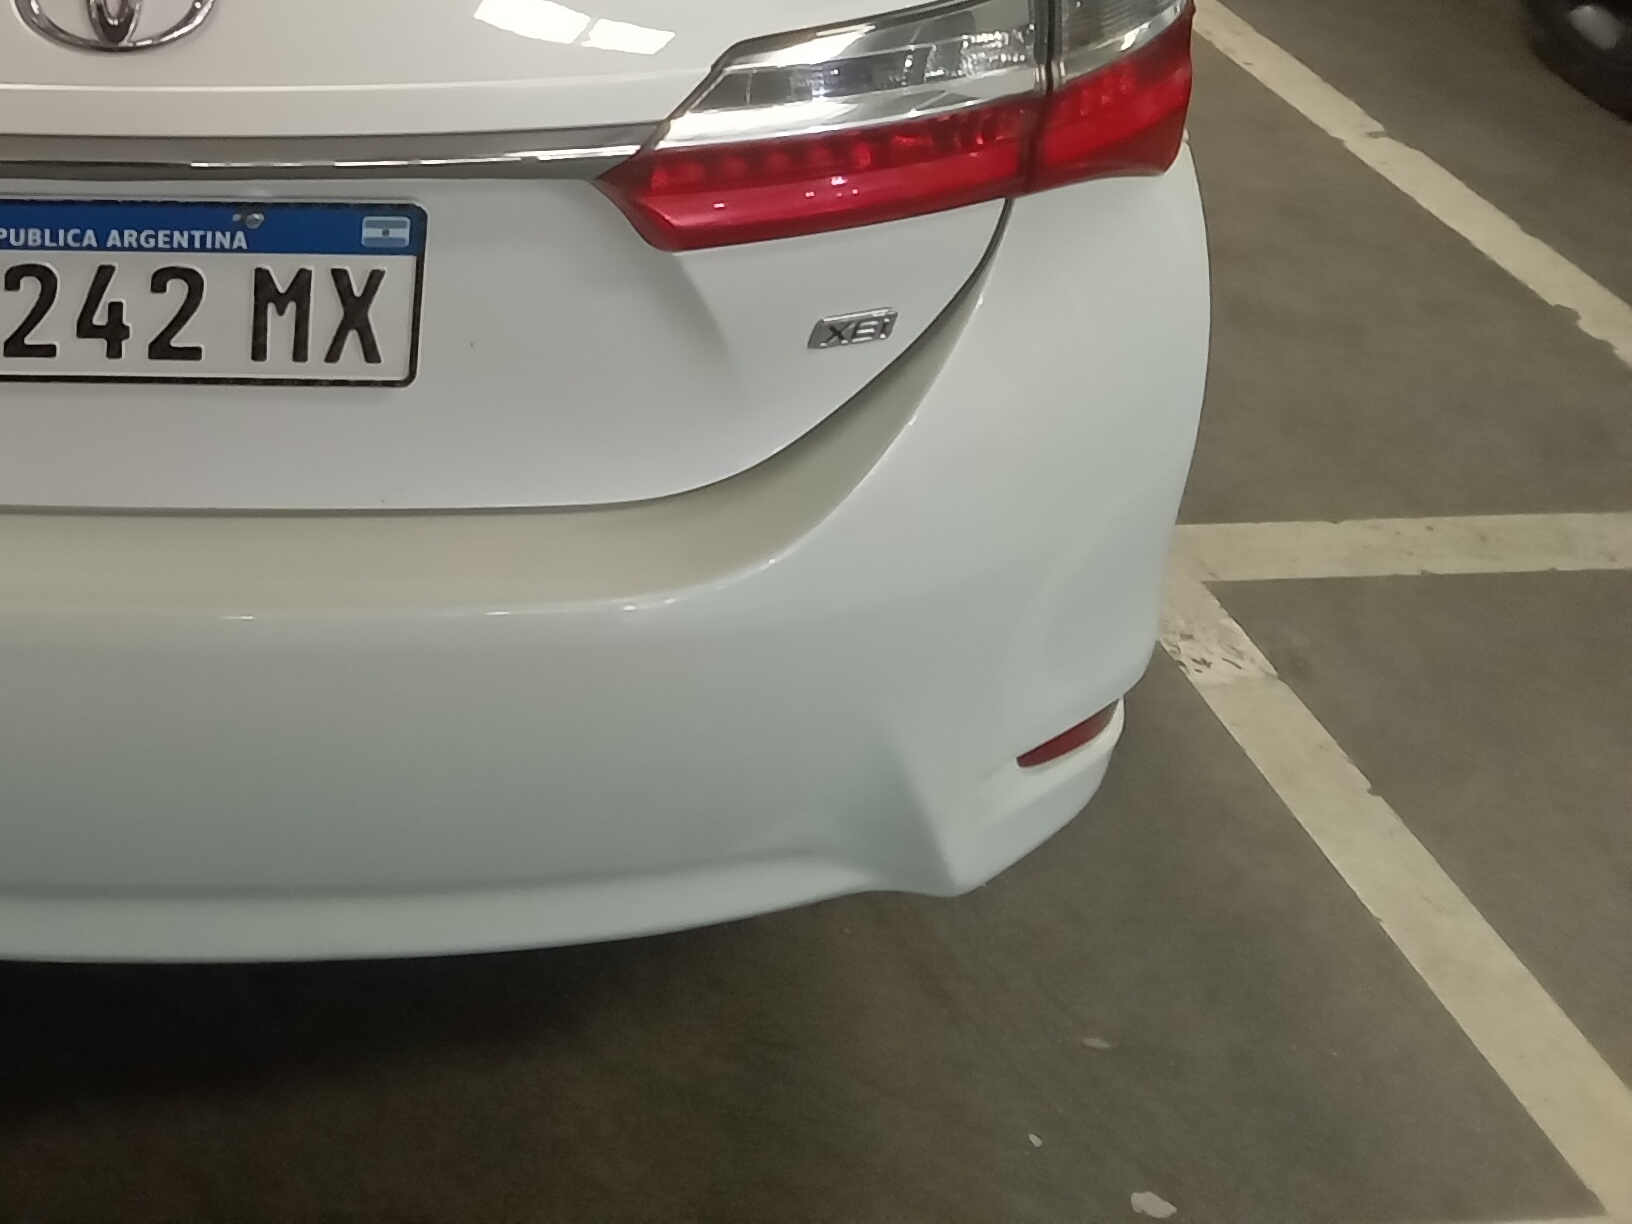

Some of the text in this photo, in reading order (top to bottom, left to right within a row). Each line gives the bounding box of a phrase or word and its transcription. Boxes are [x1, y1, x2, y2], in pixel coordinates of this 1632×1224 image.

[106, 228, 248, 250] ARGENTINA
[2, 262, 206, 361] 242
[250, 266, 387, 364] MX
